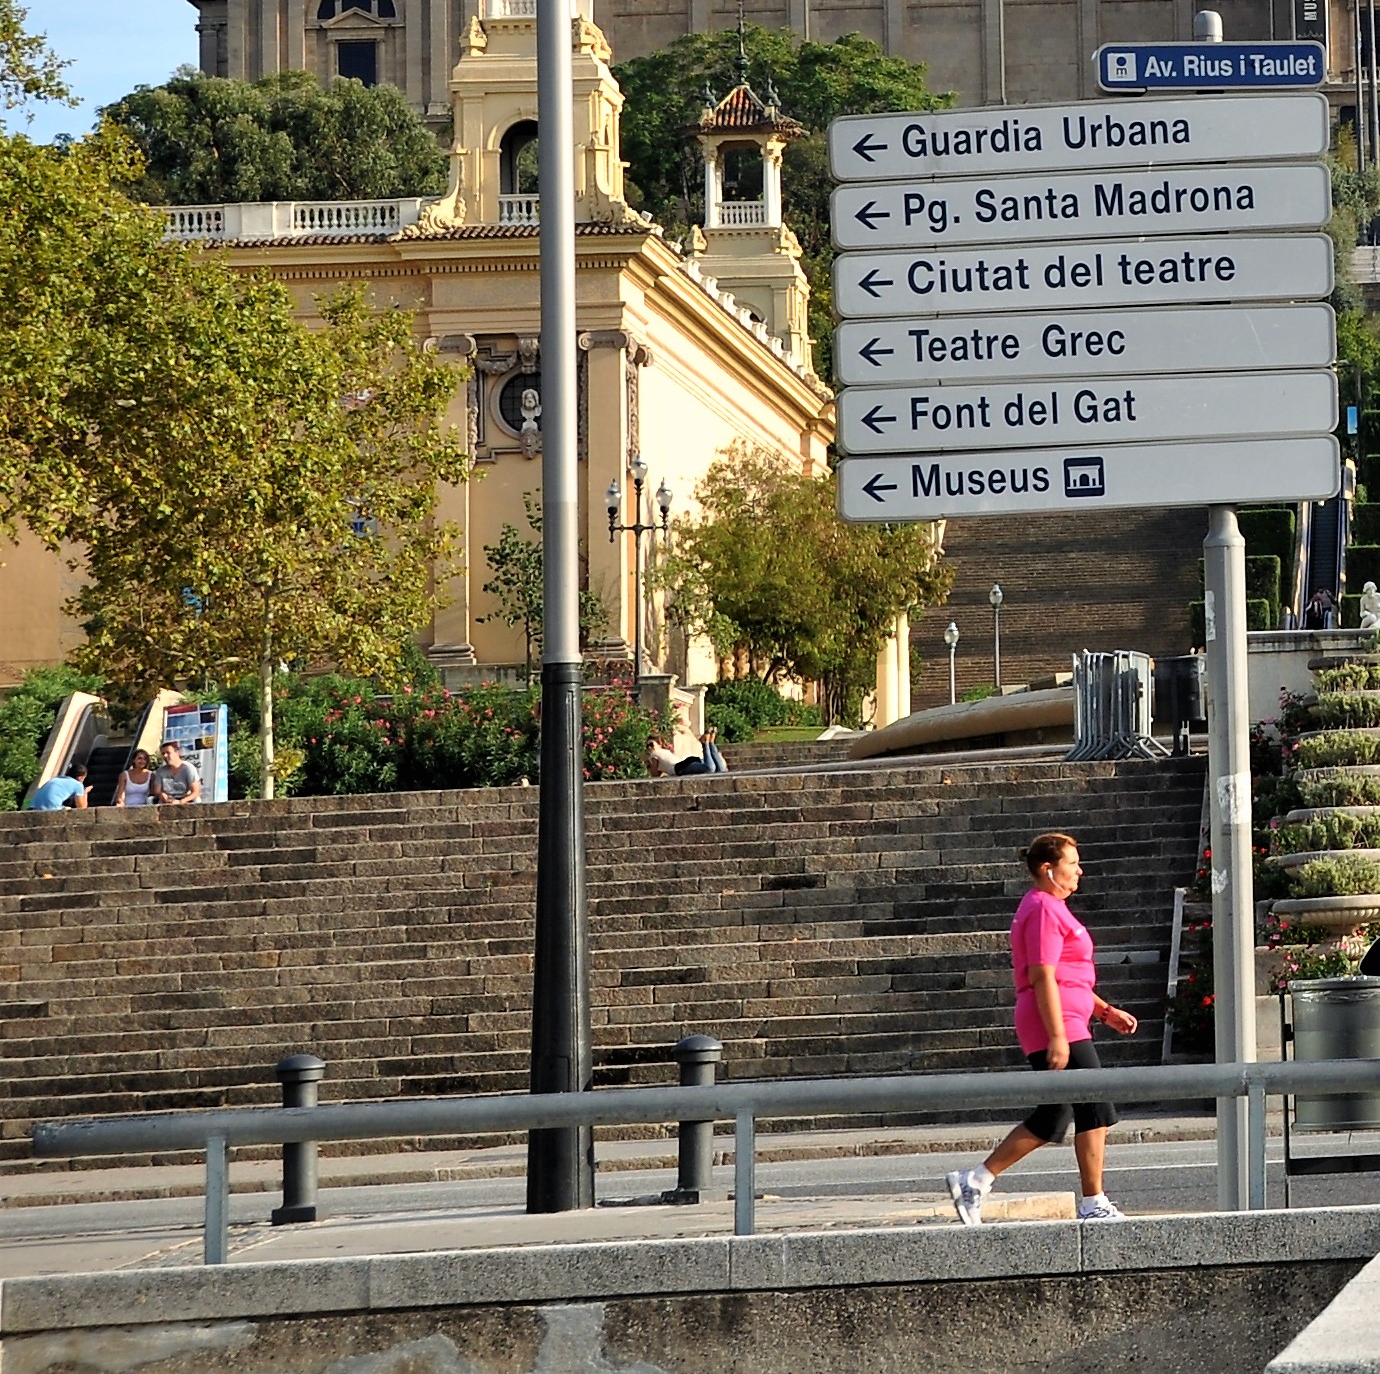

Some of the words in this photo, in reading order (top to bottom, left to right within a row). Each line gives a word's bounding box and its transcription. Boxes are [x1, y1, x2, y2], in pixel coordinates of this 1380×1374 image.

[1144, 56, 1176, 78] Av.
[1183, 54, 1233, 77] Rius
[1239, 54, 1245, 76] i
[1249, 53, 1316, 77] Taulet
[901, 119, 1043, 159] Guardia
[1062, 114, 1191, 150] Urbana
[903, 192, 961, 233] Pg.
[974, 188, 1080, 223] Santa
[1094, 181, 1256, 217] Madrona
[907, 258, 1030, 295] Ciutat
[1043, 253, 1103, 289] del
[1117, 251, 1236, 286] teatre
[908, 328, 1021, 363] Teatre
[1041, 323, 1126, 357] Grec
[910, 396, 991, 431] Font
[1003, 391, 1058, 427] del
[1073, 389, 1137, 424] Gat
[911, 463, 1051, 498] Museus
